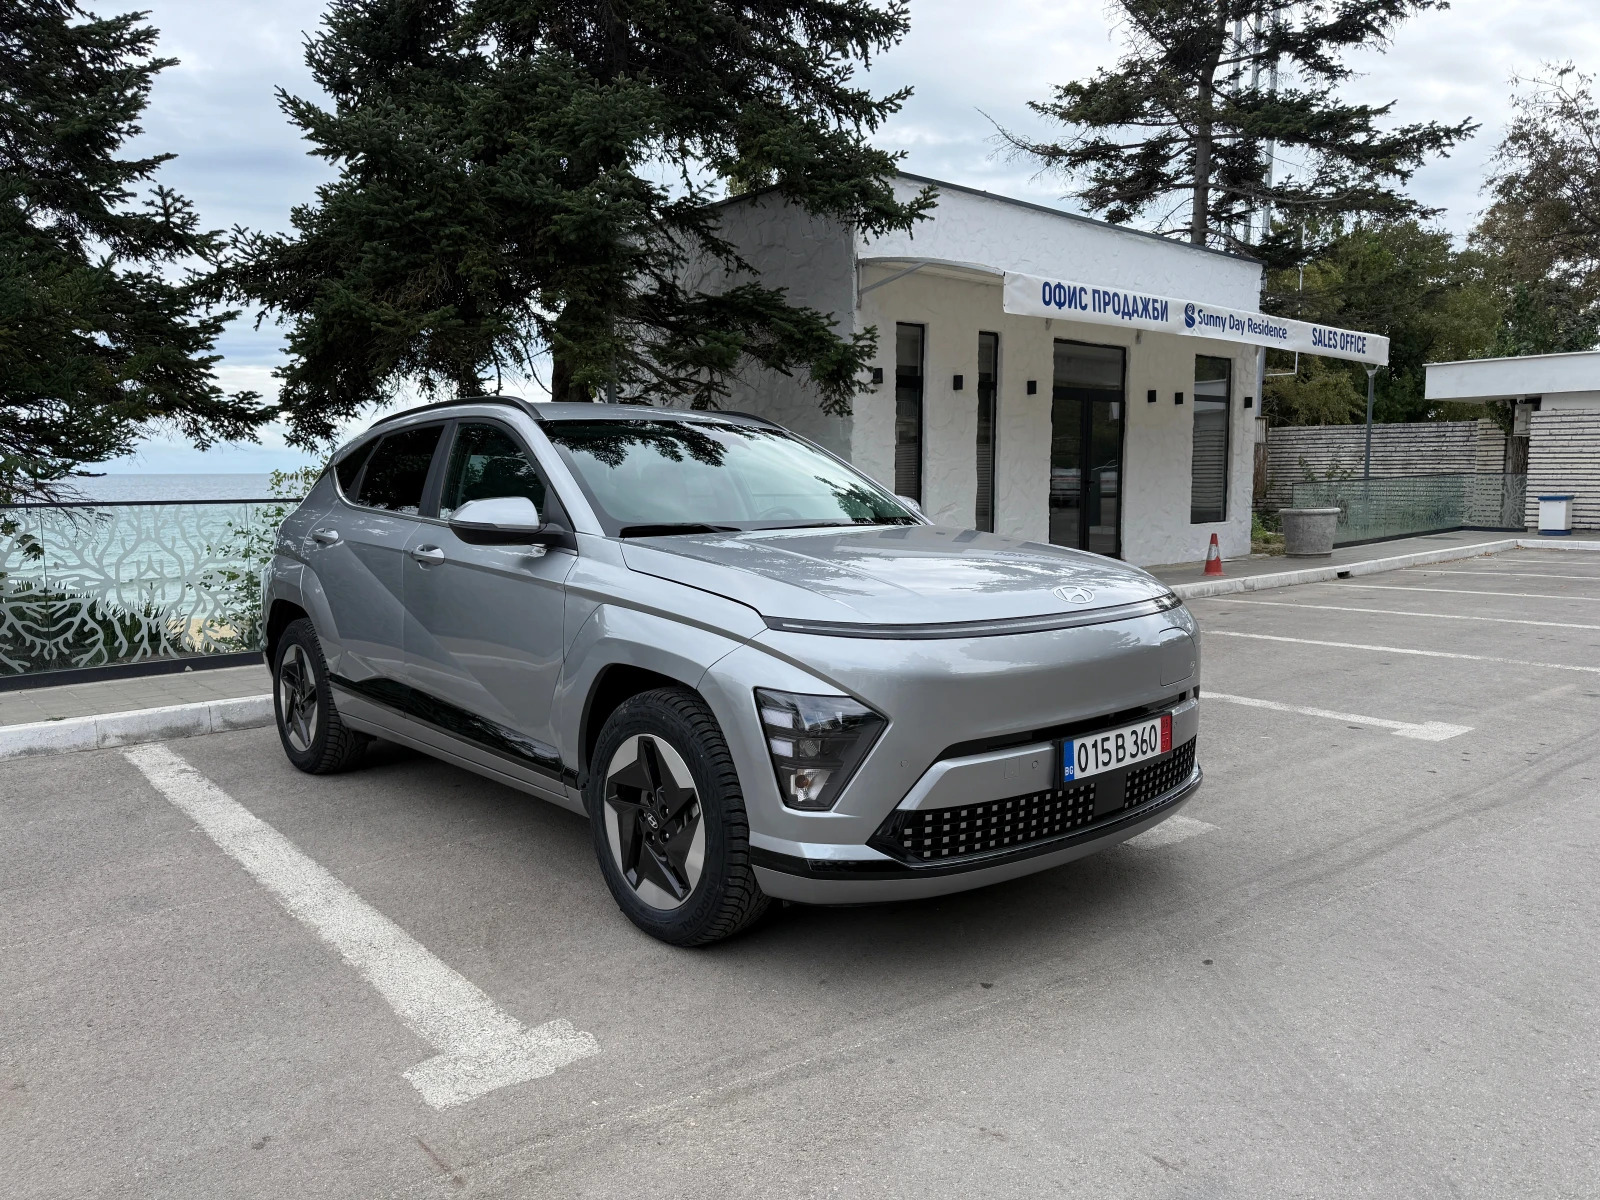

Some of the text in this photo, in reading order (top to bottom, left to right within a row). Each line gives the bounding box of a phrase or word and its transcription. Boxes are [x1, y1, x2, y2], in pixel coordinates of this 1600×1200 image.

[1042, 281, 1169, 322] ОФИС ПРОДАЖБИ
[1198, 309, 1287, 339] Sunny Day Residence
[1312, 327, 1367, 354] SALES OFFICE
[1064, 765, 1074, 776] BG
